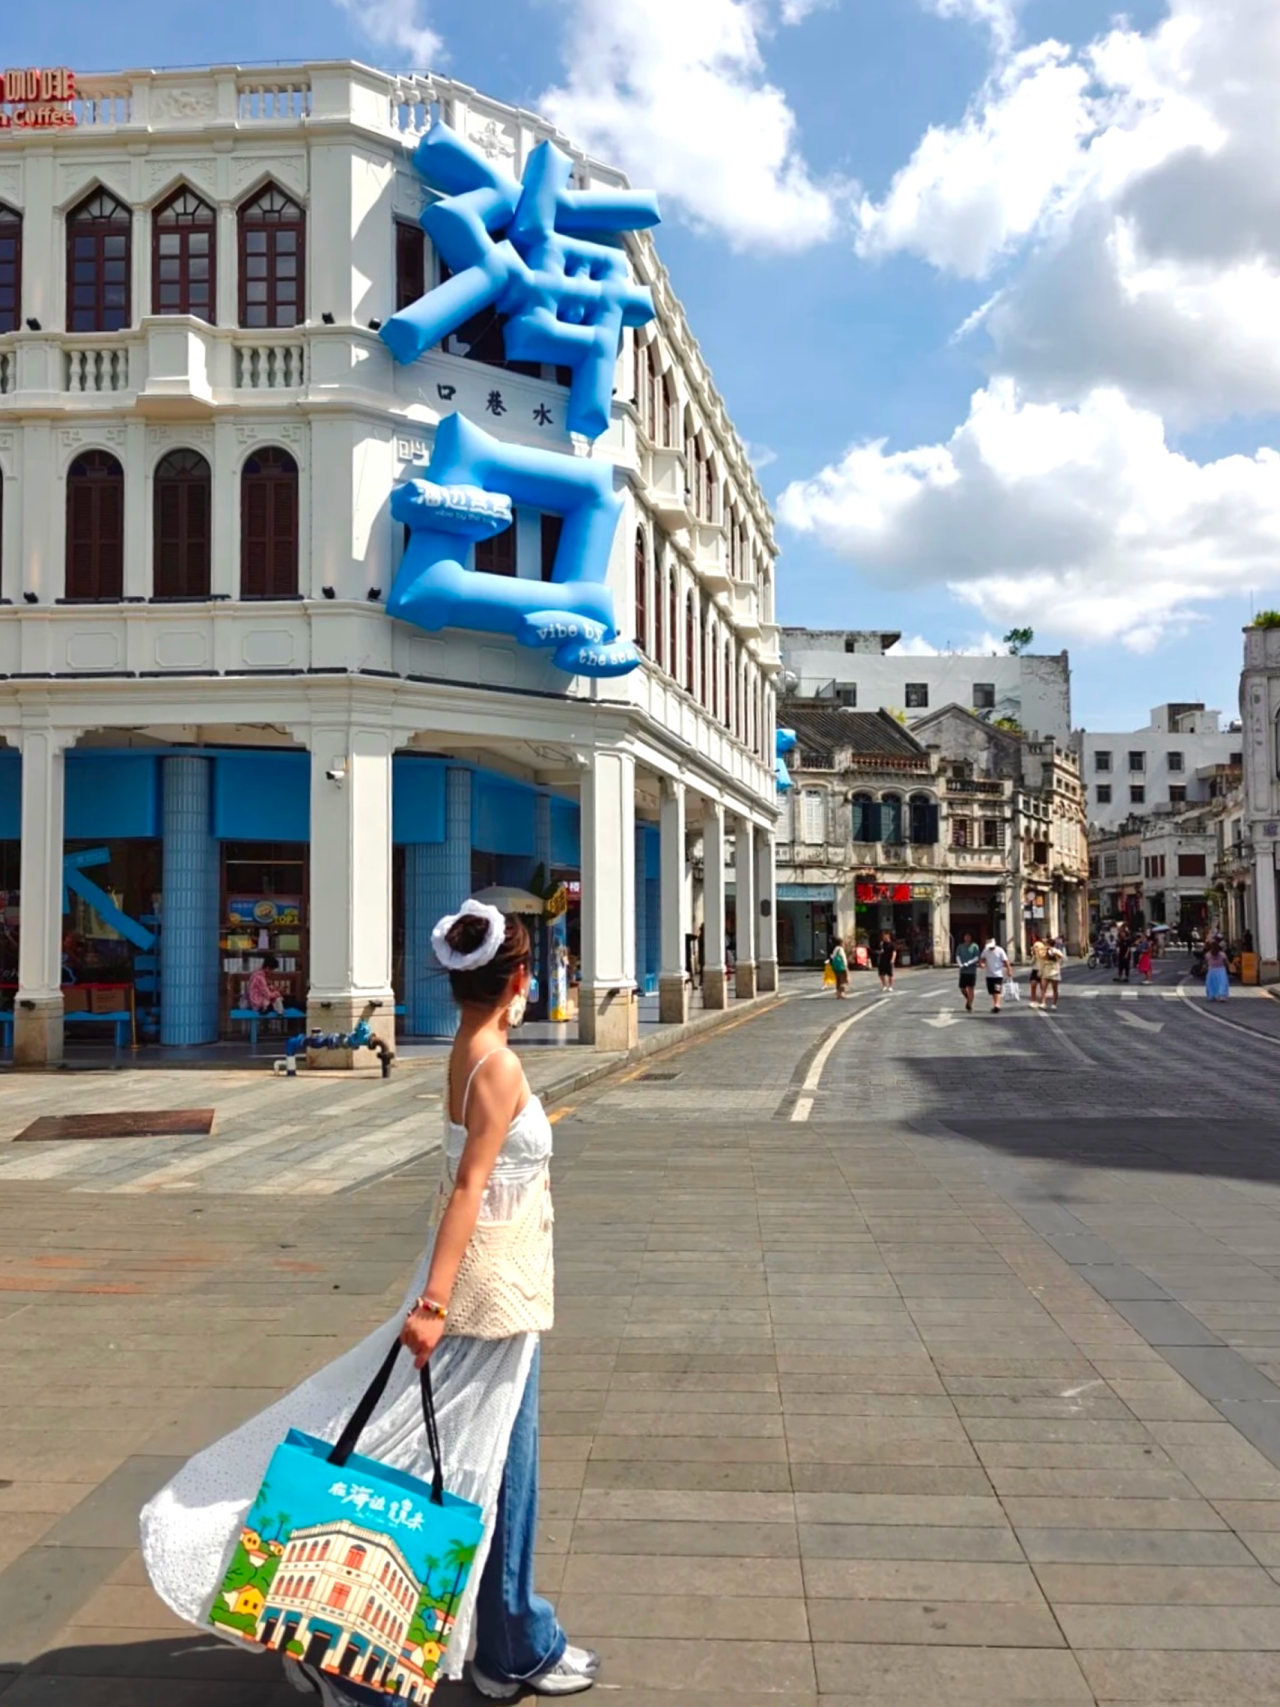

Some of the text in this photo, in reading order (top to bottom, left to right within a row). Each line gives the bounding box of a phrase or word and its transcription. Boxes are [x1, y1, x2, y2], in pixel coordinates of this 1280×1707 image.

[537, 621, 604, 644] vibe by
[578, 648, 606, 667] the
